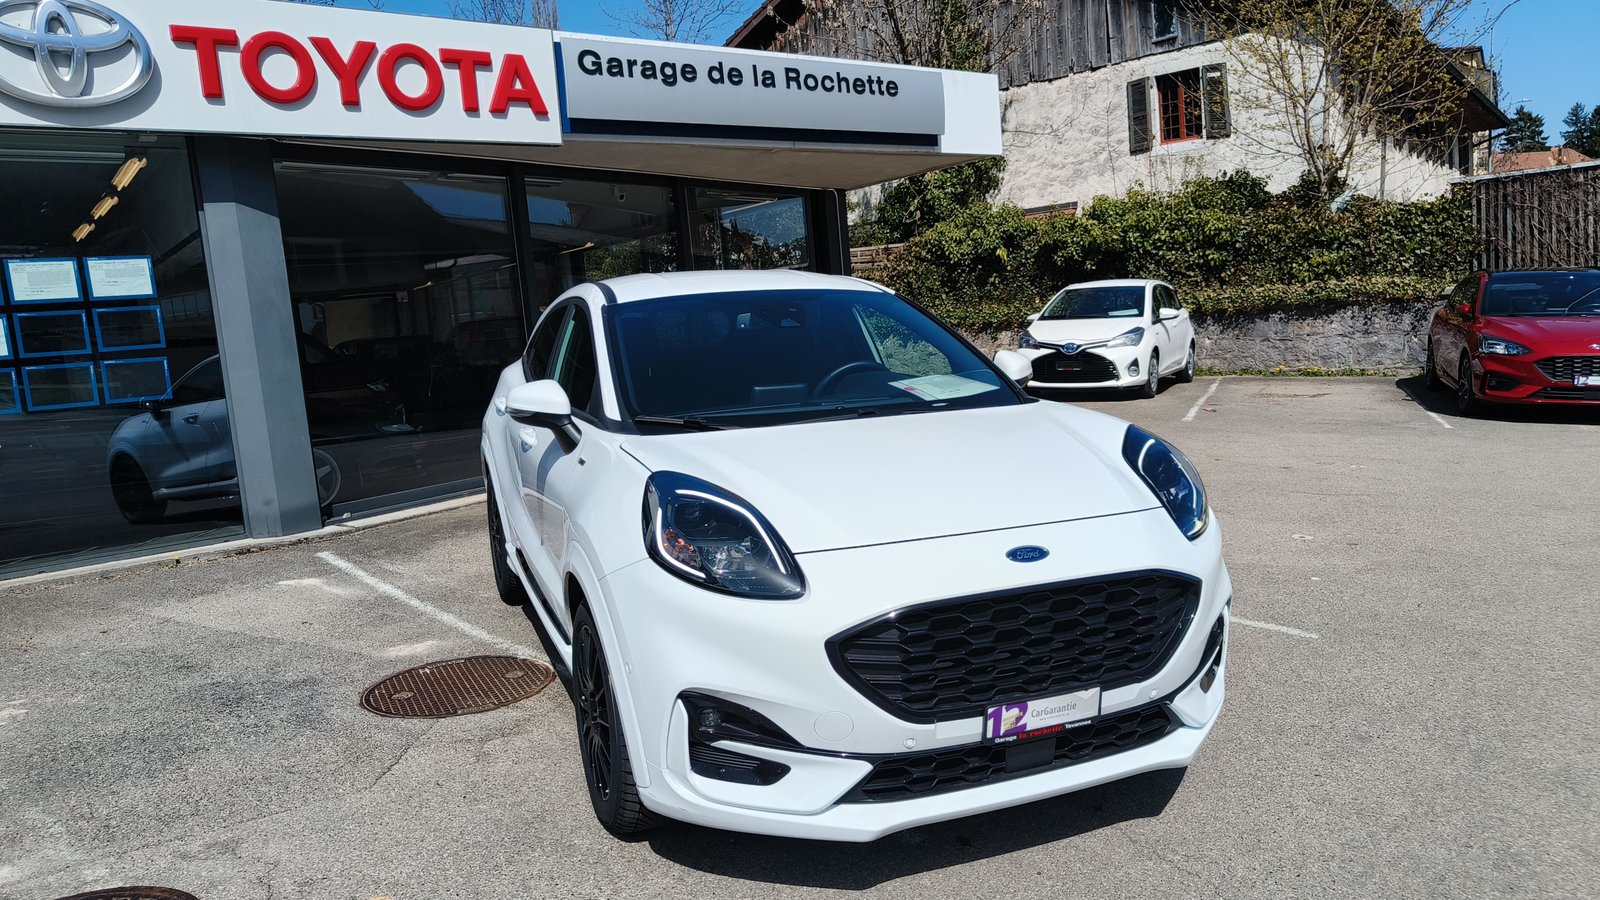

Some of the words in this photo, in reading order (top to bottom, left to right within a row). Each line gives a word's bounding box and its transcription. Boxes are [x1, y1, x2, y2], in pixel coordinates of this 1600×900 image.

[169, 24, 549, 117] TOYOTA
[577, 49, 697, 87] Garage
[707, 61, 743, 86] de
[752, 64, 777, 89] la
[784, 67, 900, 98] Rochette
[1016, 548, 1041, 560] Ford
[988, 701, 1028, 738] 12
[1031, 701, 1077, 718] CarGarantie
[994, 735, 1018, 744] Garage
